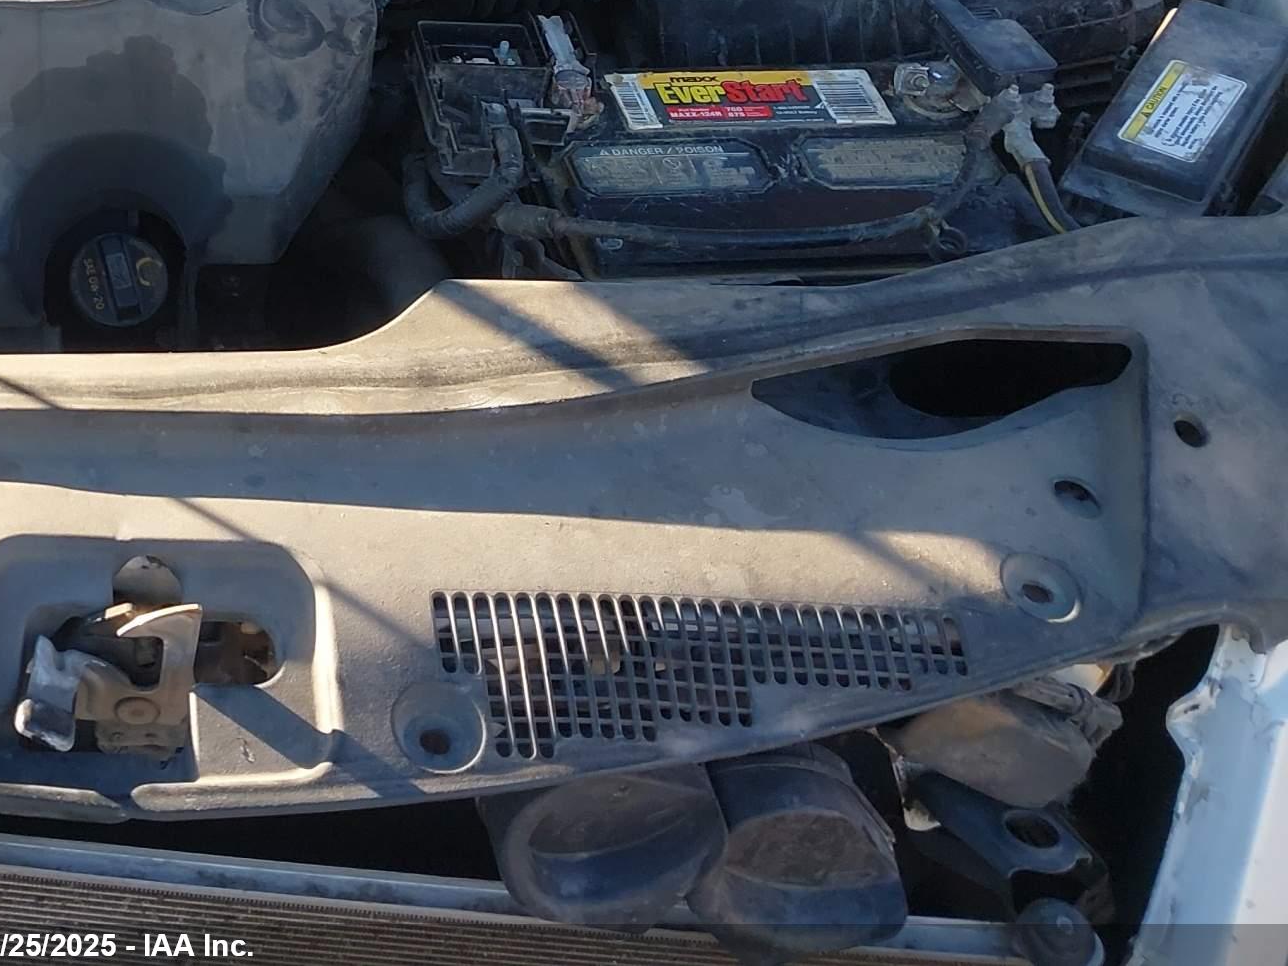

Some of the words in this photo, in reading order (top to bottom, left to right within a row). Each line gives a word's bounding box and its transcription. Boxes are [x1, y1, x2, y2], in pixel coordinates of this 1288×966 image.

[669, 75, 719, 84] maxx
[1145, 86, 1168, 110] CAUTION
[611, 147, 664, 156] DANGER
[674, 145, 725, 154] POISON
